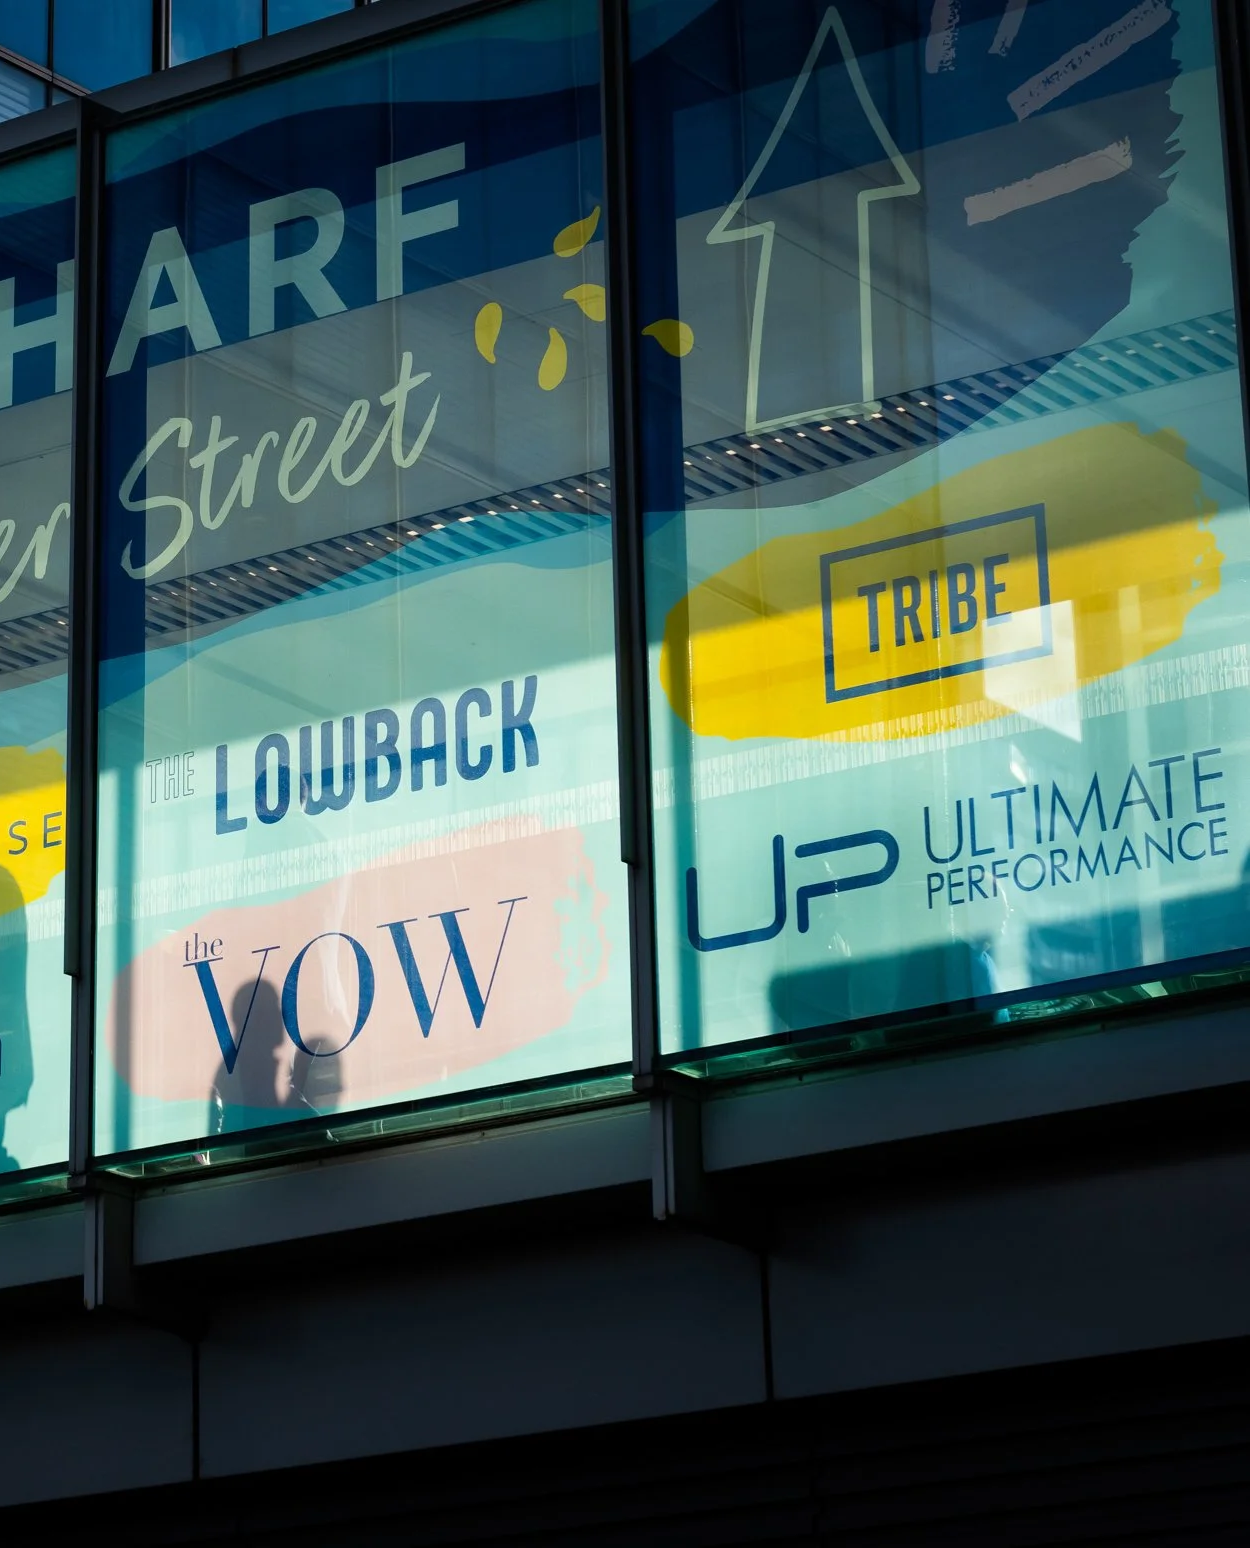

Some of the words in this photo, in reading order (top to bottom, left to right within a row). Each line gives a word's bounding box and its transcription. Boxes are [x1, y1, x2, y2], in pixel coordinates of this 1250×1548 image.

[119, 351, 440, 580] Street
[857, 553, 1014, 654] TRIBE
[146, 751, 195, 804] THE
[215, 675, 540, 835] LOWBACK
[924, 747, 1226, 865] ULTIMATE
[686, 829, 900, 953] UP
[926, 817, 1230, 910] PERFORMANCE
[183, 933, 224, 963] the
[183, 896, 528, 1075] VOW
